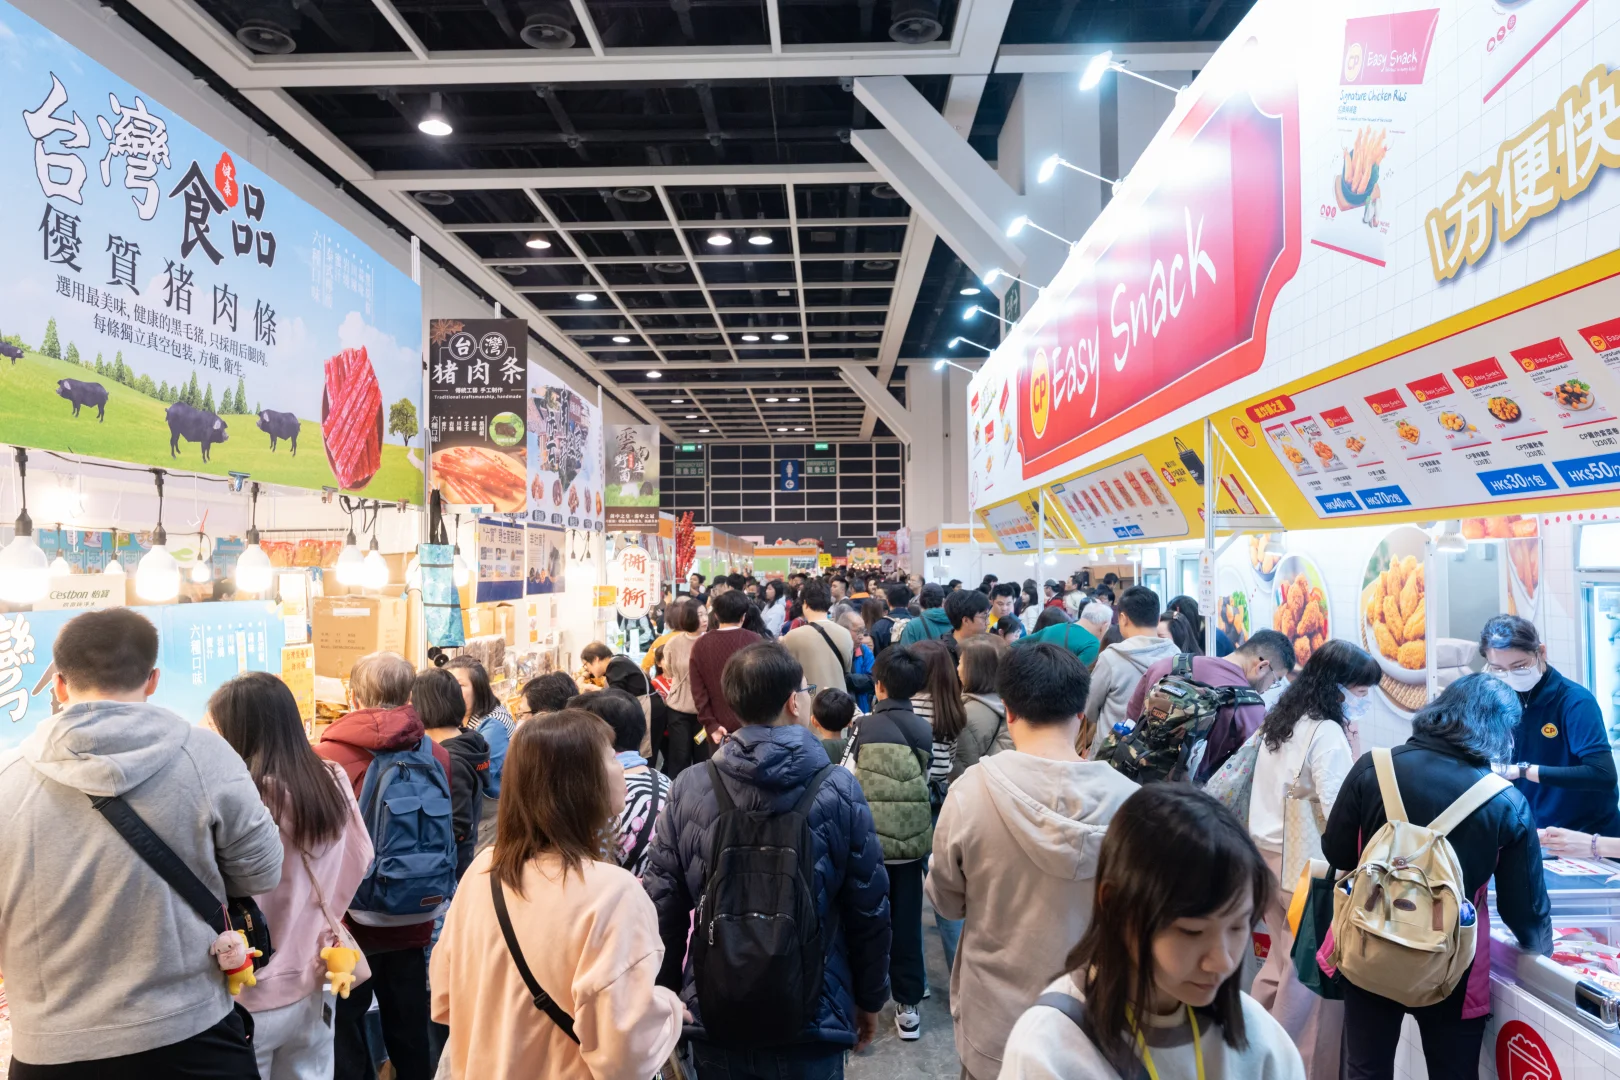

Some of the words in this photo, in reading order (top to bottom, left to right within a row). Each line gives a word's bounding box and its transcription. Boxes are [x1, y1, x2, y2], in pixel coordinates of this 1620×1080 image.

[1367, 51, 1388, 73] Easy
[1389, 47, 1418, 67] Snack
[1368, 88, 1392, 102] Chicken
[1033, 373, 1047, 415] CP
[1052, 325, 1100, 419] Easy
[1110, 205, 1217, 373] Snack
[455, 336, 503, 357] 台灣
[1236, 423, 1250, 442] CP
[1543, 726, 1556, 734] CP
